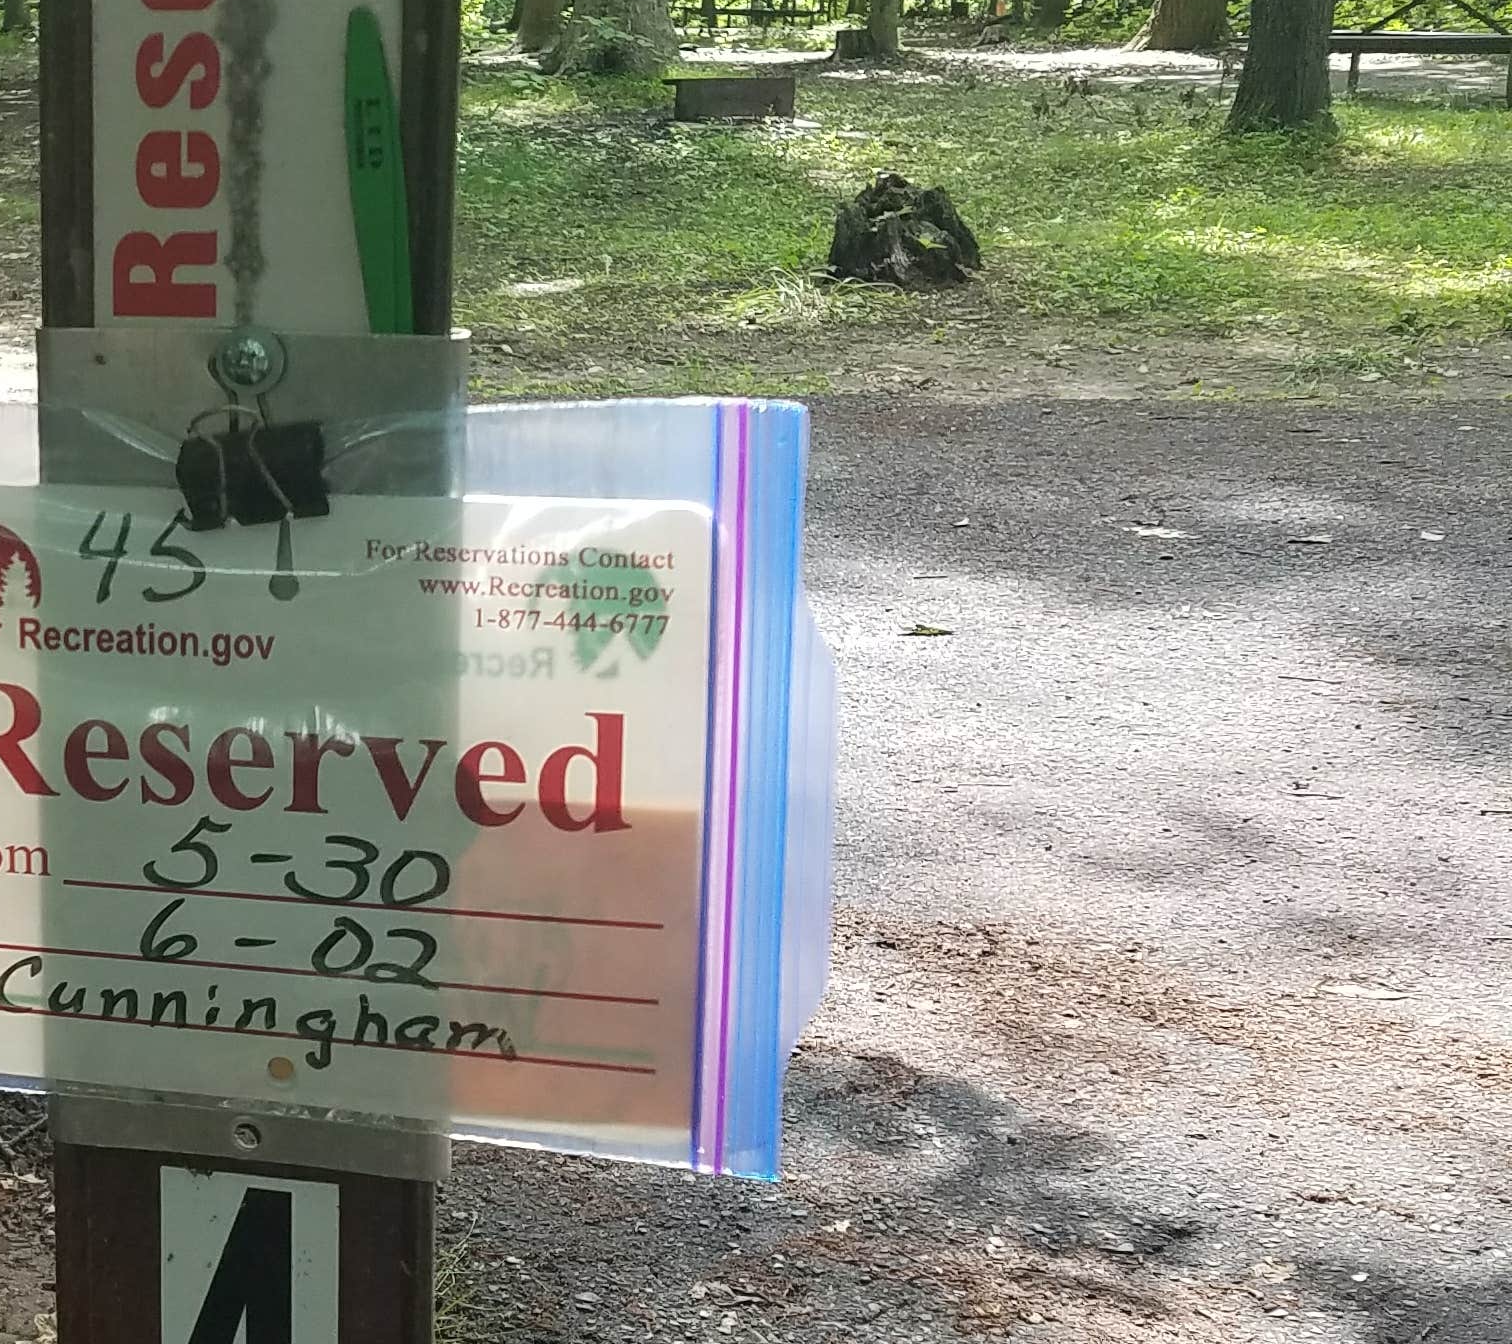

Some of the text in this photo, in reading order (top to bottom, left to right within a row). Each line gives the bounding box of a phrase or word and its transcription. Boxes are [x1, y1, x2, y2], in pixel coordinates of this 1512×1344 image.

[78, 507, 208, 604] 45
[365, 538, 676, 570] For Reservations Contact
[418, 574, 676, 606] www.Recreation.gov
[473, 607, 671, 635] 1-877-444-6777
[17, 617, 275, 666] Recreation.gov
[142, 815, 451, 908] 5-30
